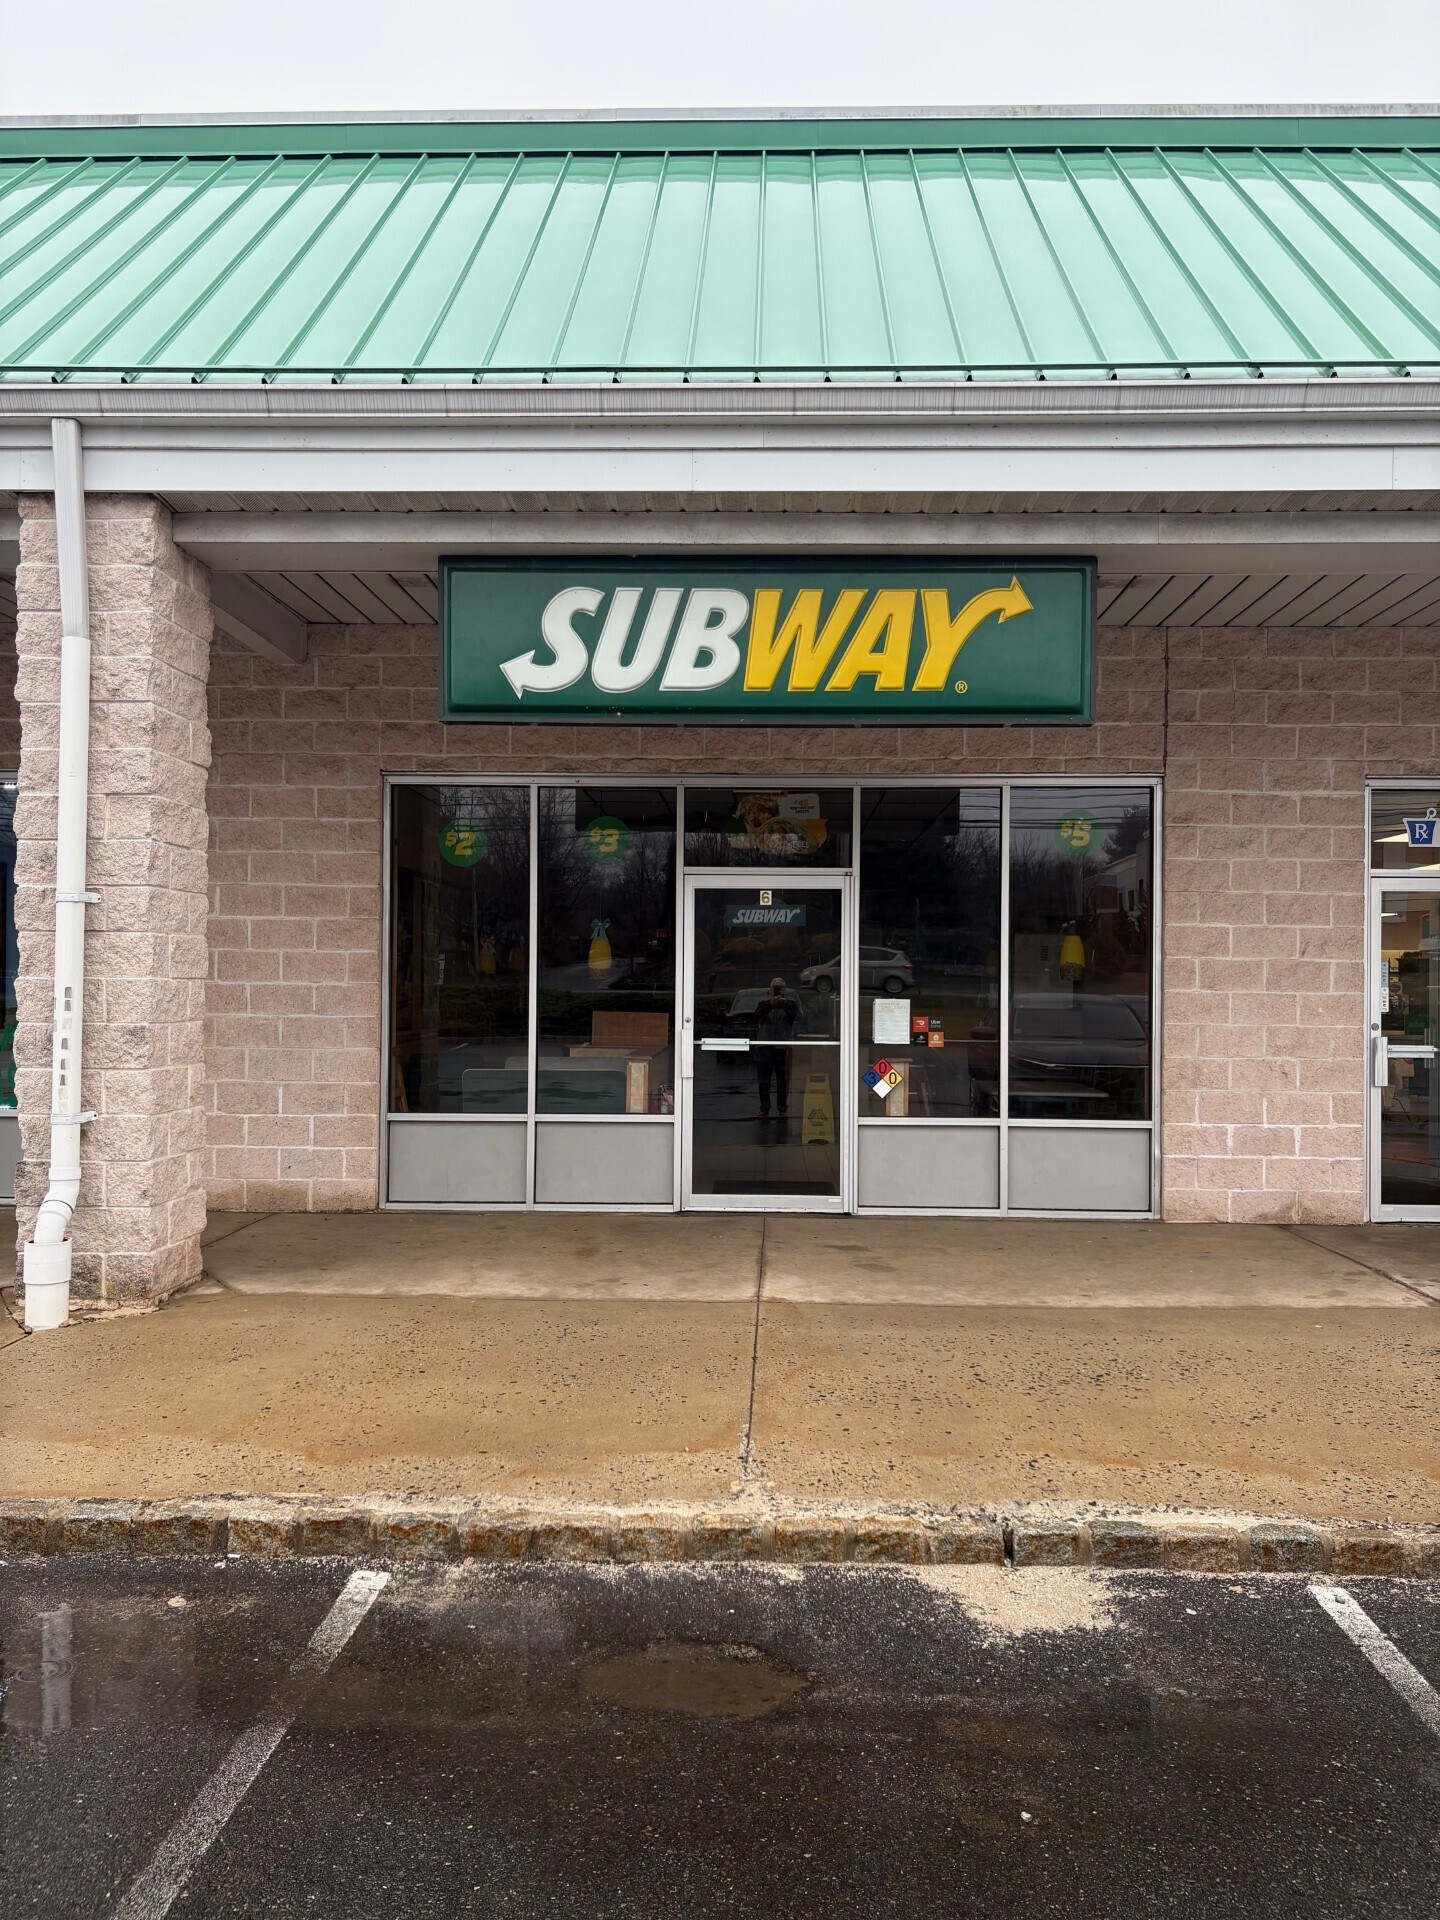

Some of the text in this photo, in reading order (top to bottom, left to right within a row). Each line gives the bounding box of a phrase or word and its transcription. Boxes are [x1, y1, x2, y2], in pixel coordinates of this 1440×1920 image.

[500, 576, 1034, 698] SUBWAY
[445, 829, 475, 856] $2
[590, 827, 619, 852] $3
[1060, 820, 1091, 847] $5
[761, 891, 770, 904] 6
[732, 907, 801, 924] SUBWAY
[868, 1072, 897, 1084] 3 0
[879, 1061, 887, 1074] 0
